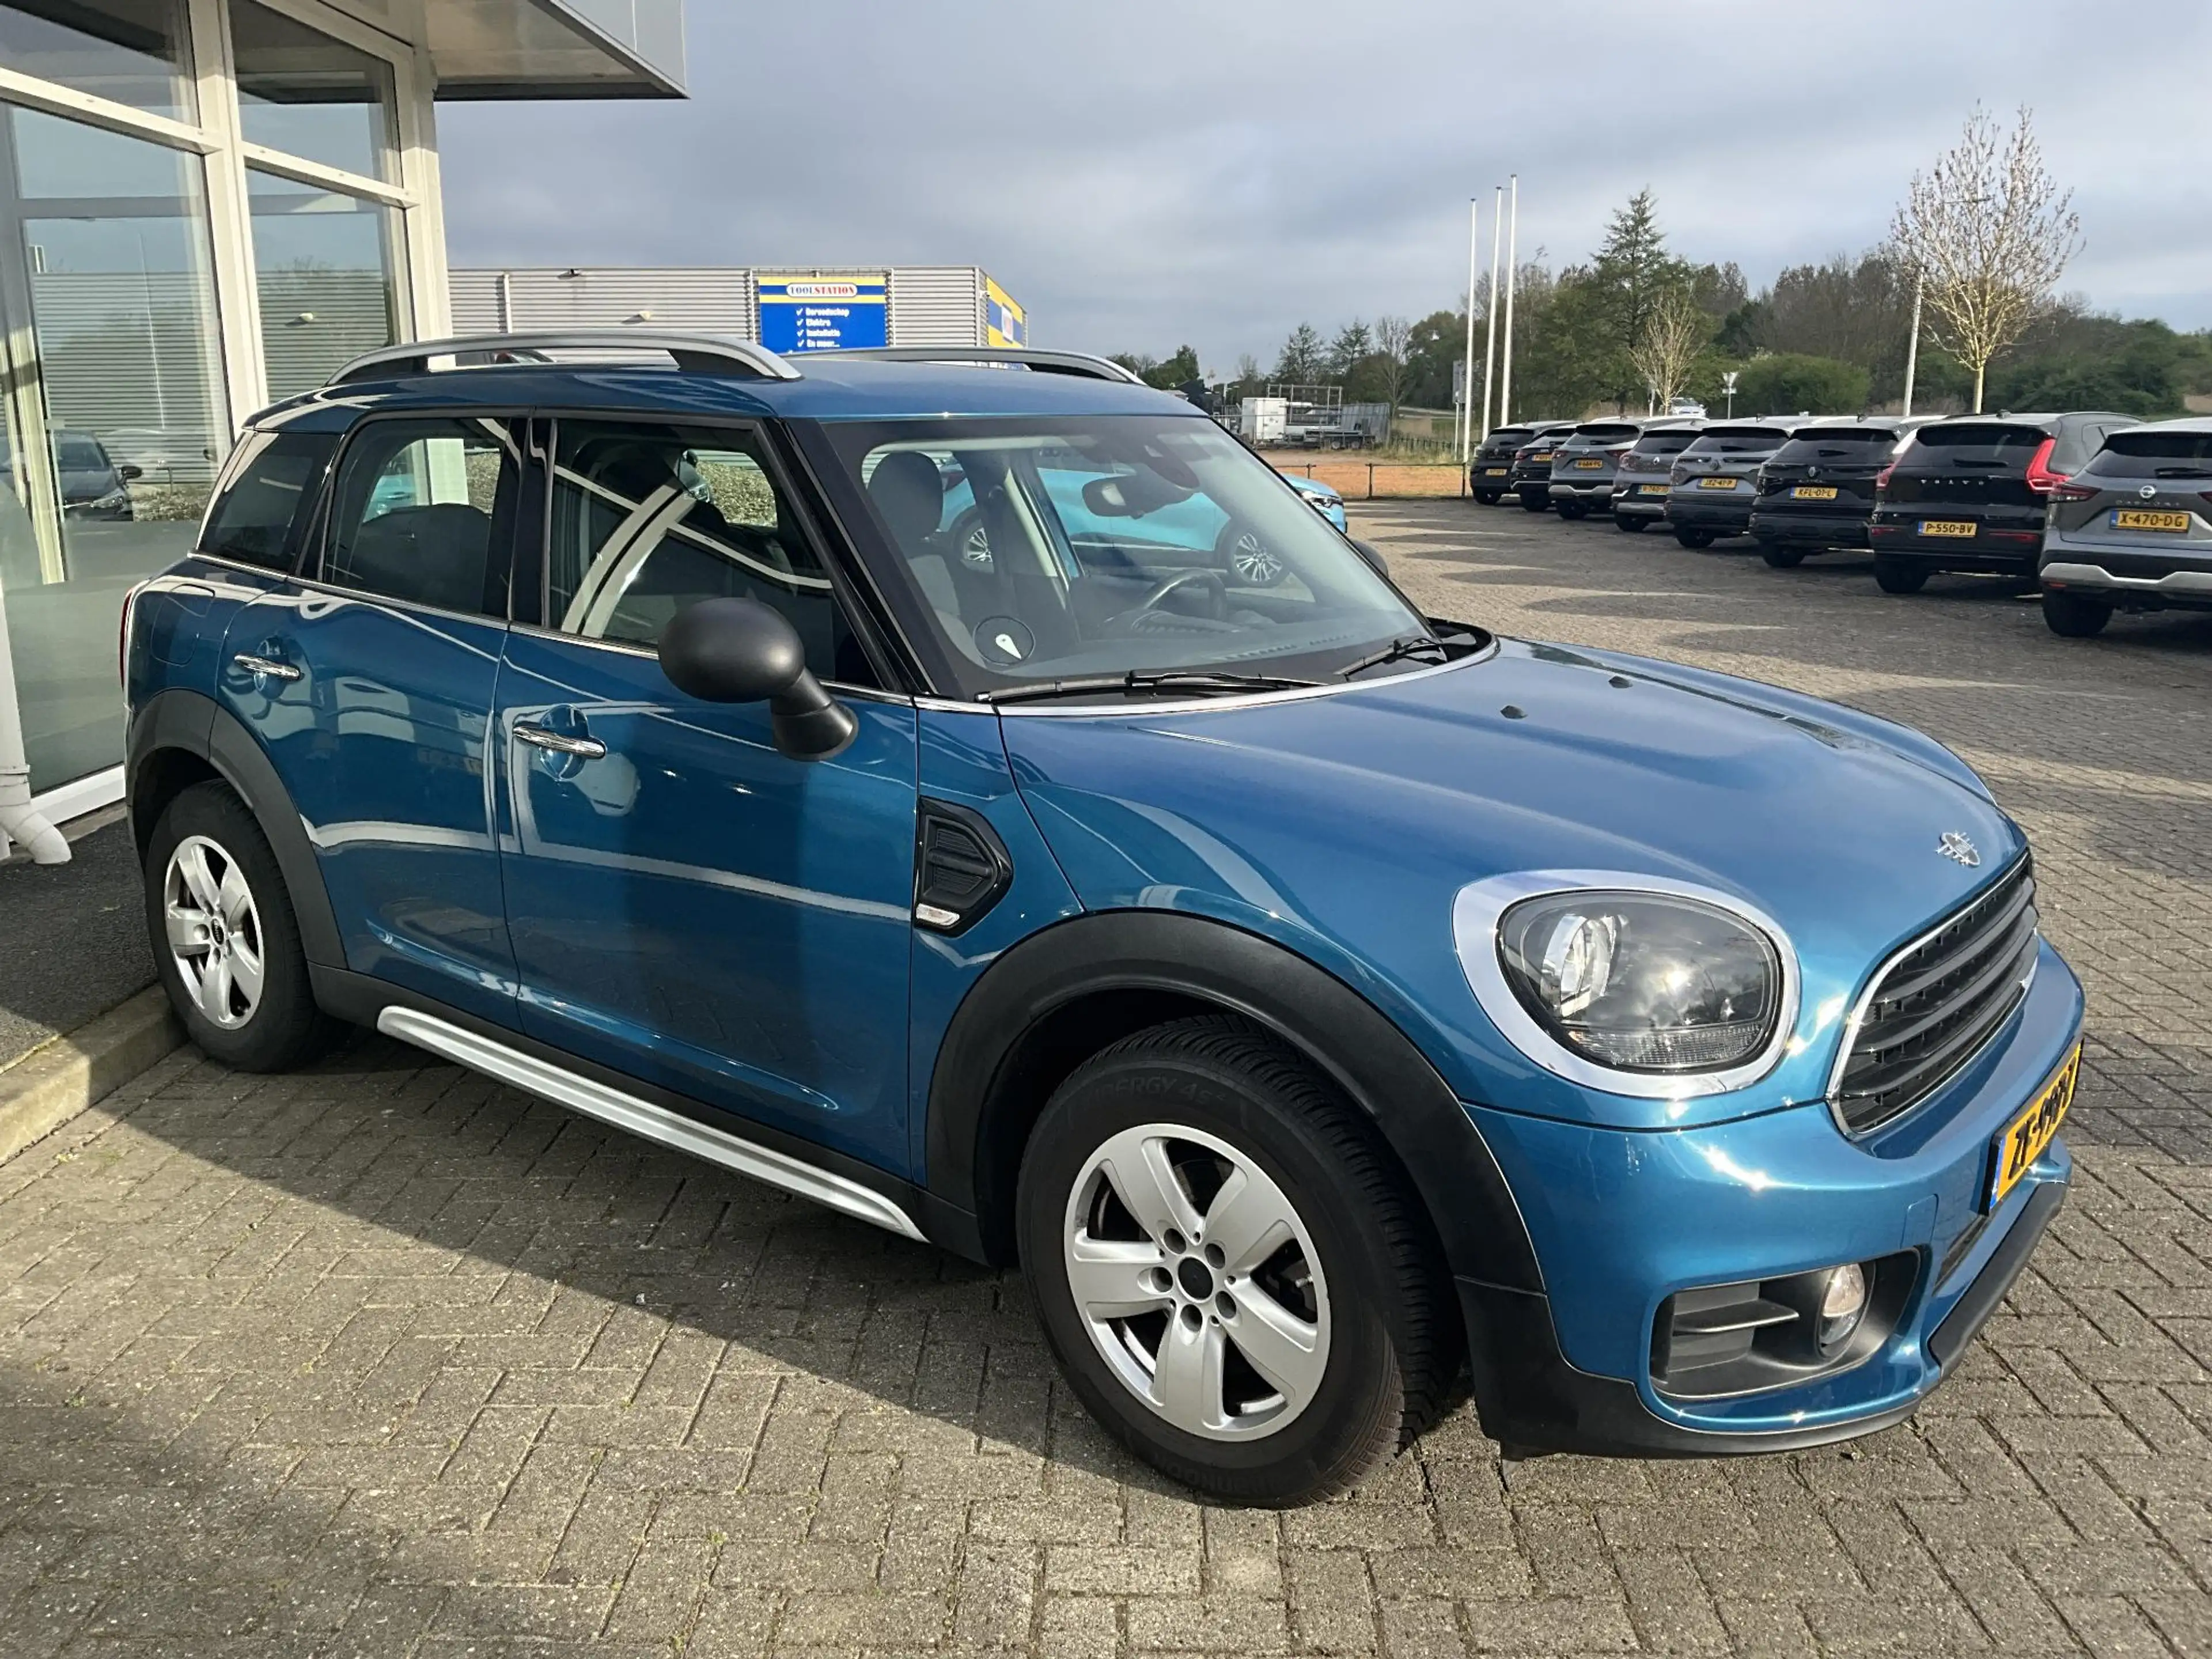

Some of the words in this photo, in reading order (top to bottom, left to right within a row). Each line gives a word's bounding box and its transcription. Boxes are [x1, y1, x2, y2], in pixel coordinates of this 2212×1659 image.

[790, 286, 854, 294] TOOLSTATION
[2120, 512, 2183, 527] X-470-DG
[1925, 523, 1973, 533] P-550-BV
